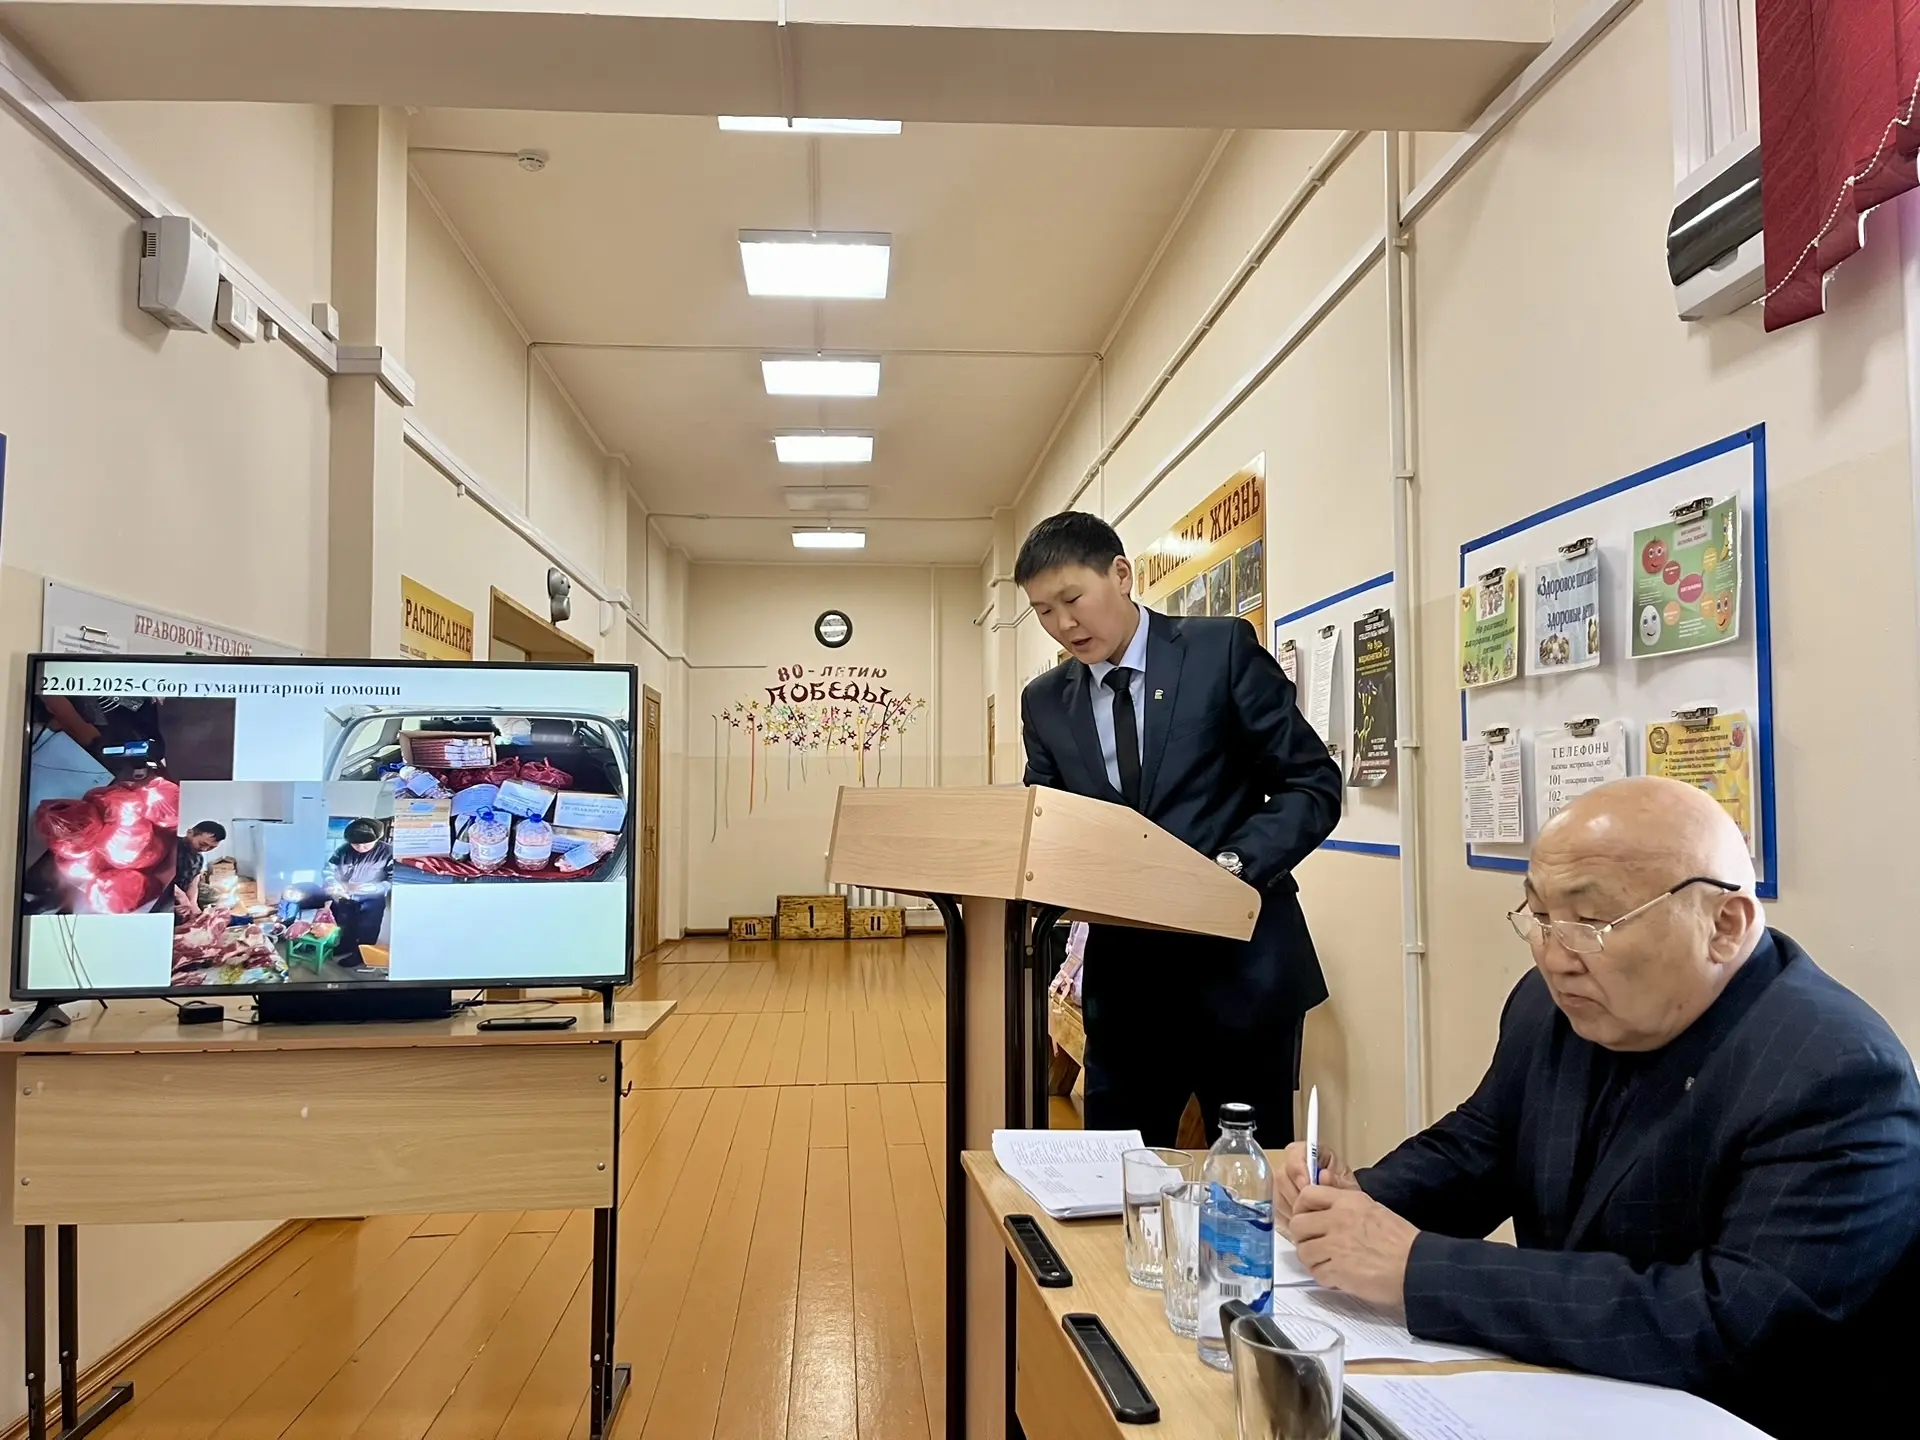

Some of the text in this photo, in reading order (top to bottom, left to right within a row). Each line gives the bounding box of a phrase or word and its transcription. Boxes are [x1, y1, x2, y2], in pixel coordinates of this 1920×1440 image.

[1210, 476, 1261, 543] ЖИЗНЬ
[405, 598, 472, 653] РАСПИСАНИЕ
[1547, 605, 1581, 633] здоровые
[134, 614, 205, 649] ПРАВОВОЙ
[207, 633, 252, 656] УГОЛОК
[41, 676, 401, 698] 22.01.2025-Сбор гуманитарной помощи
[765, 681, 893, 707] ПОБЕДЫ
[1552, 741, 1609, 759] ТЕЛЕФОНЫ
[1549, 774, 1561, 785] 101
[1548, 790, 1561, 802] 102
